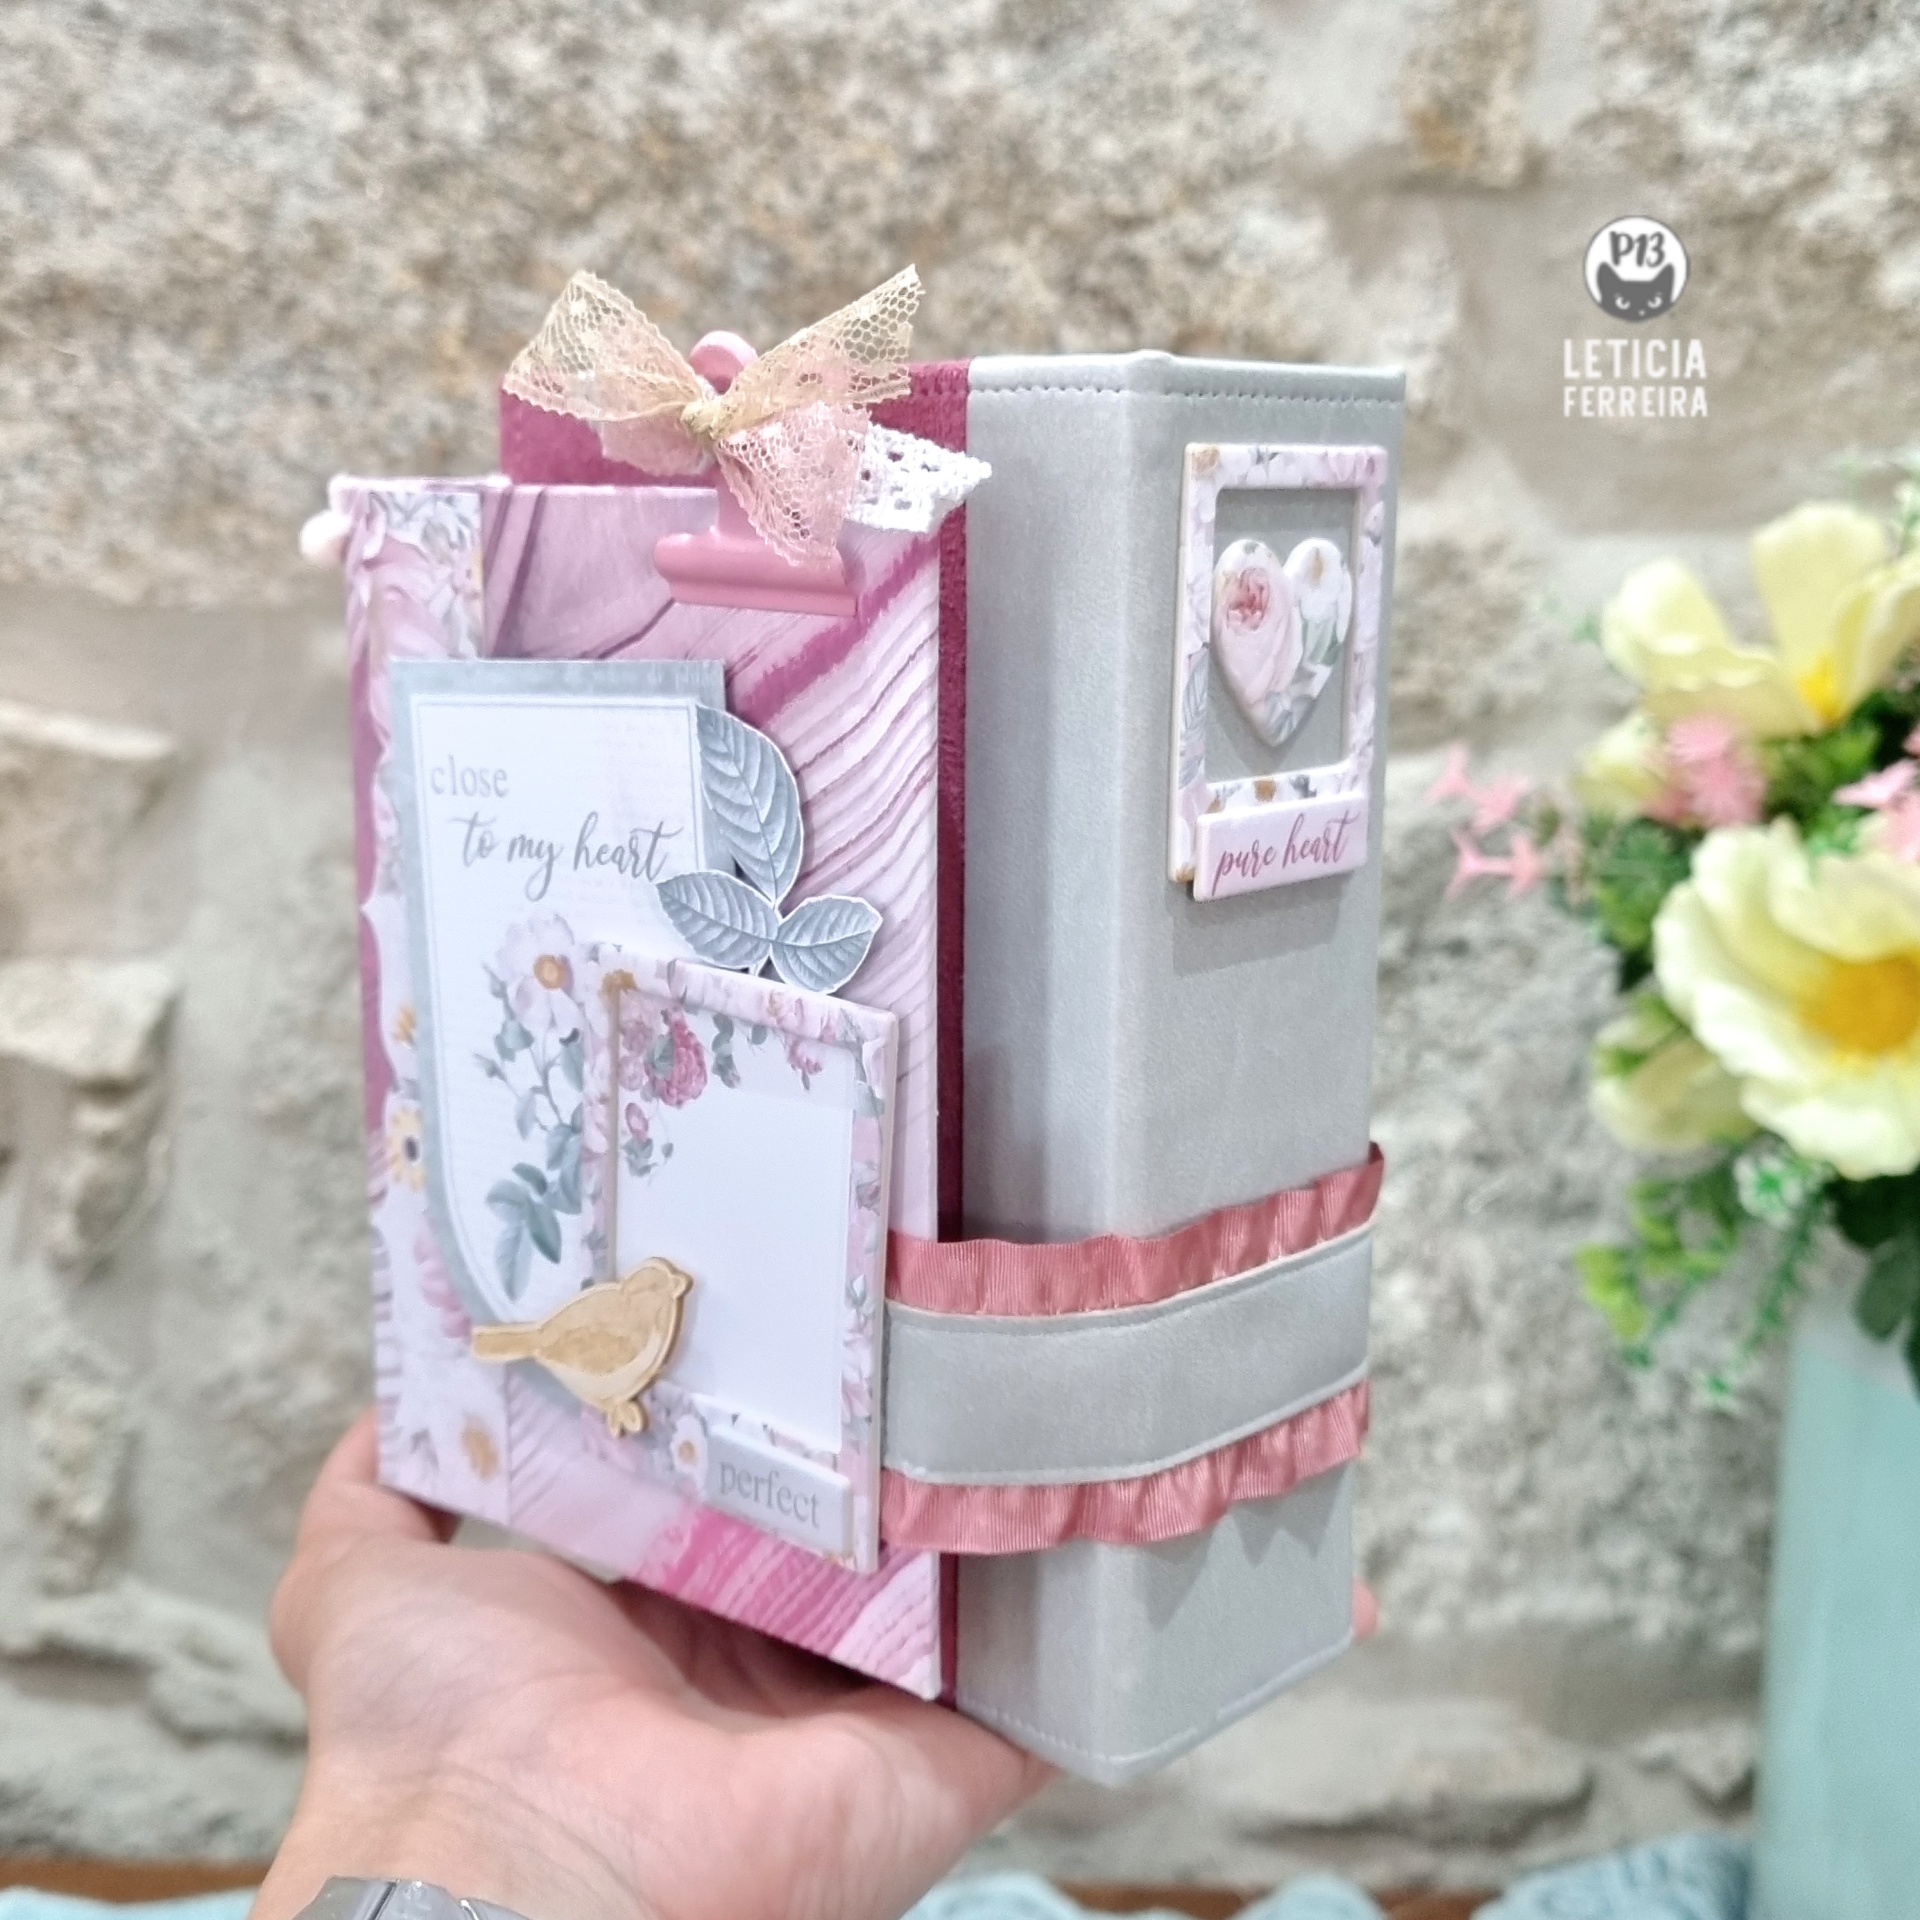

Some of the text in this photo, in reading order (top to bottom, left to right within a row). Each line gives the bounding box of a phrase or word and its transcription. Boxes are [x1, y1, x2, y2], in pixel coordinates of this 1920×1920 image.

[430, 754, 508, 797] close
[449, 811, 684, 901] to my heart
[1211, 810, 1361, 896] pure heart
[719, 1461, 820, 1530] perfect
